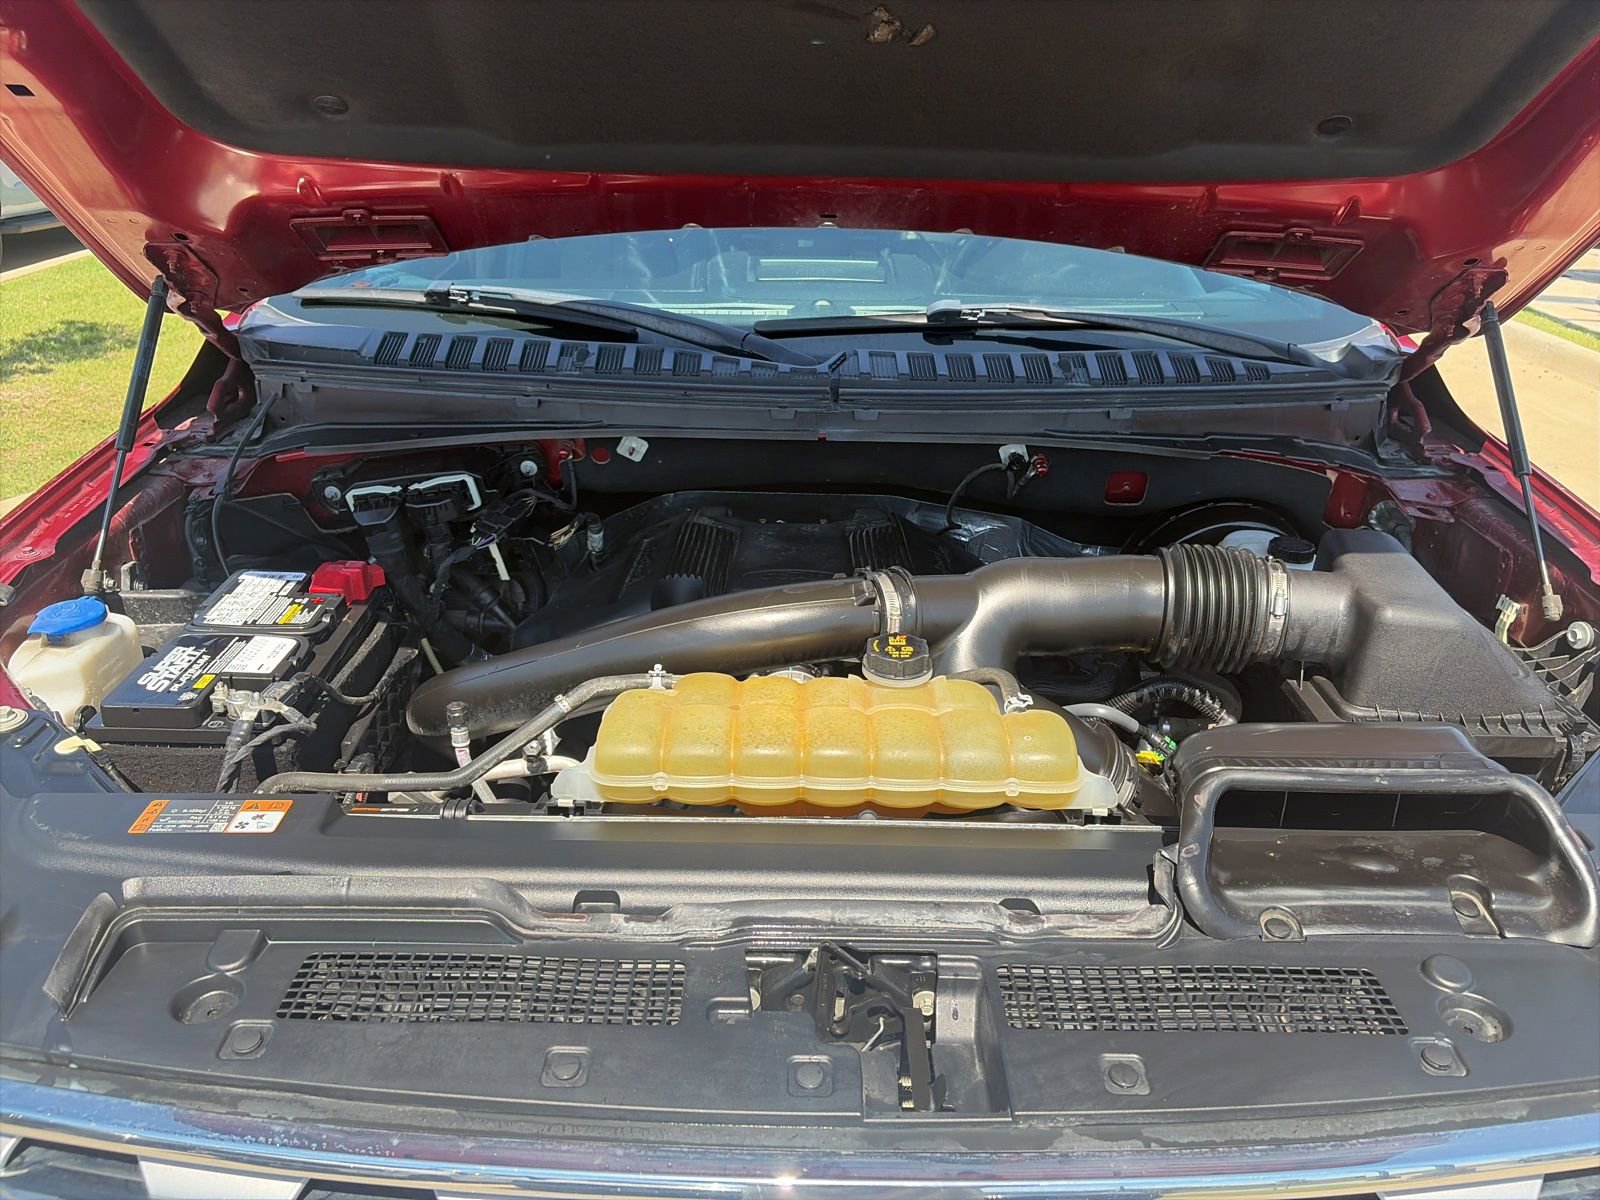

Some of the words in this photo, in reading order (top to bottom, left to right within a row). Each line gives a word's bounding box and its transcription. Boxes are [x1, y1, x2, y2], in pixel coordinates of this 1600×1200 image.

[137, 646, 192, 686] SUPER
[145, 646, 207, 693] START
[169, 655, 211, 692] PLATINUM
